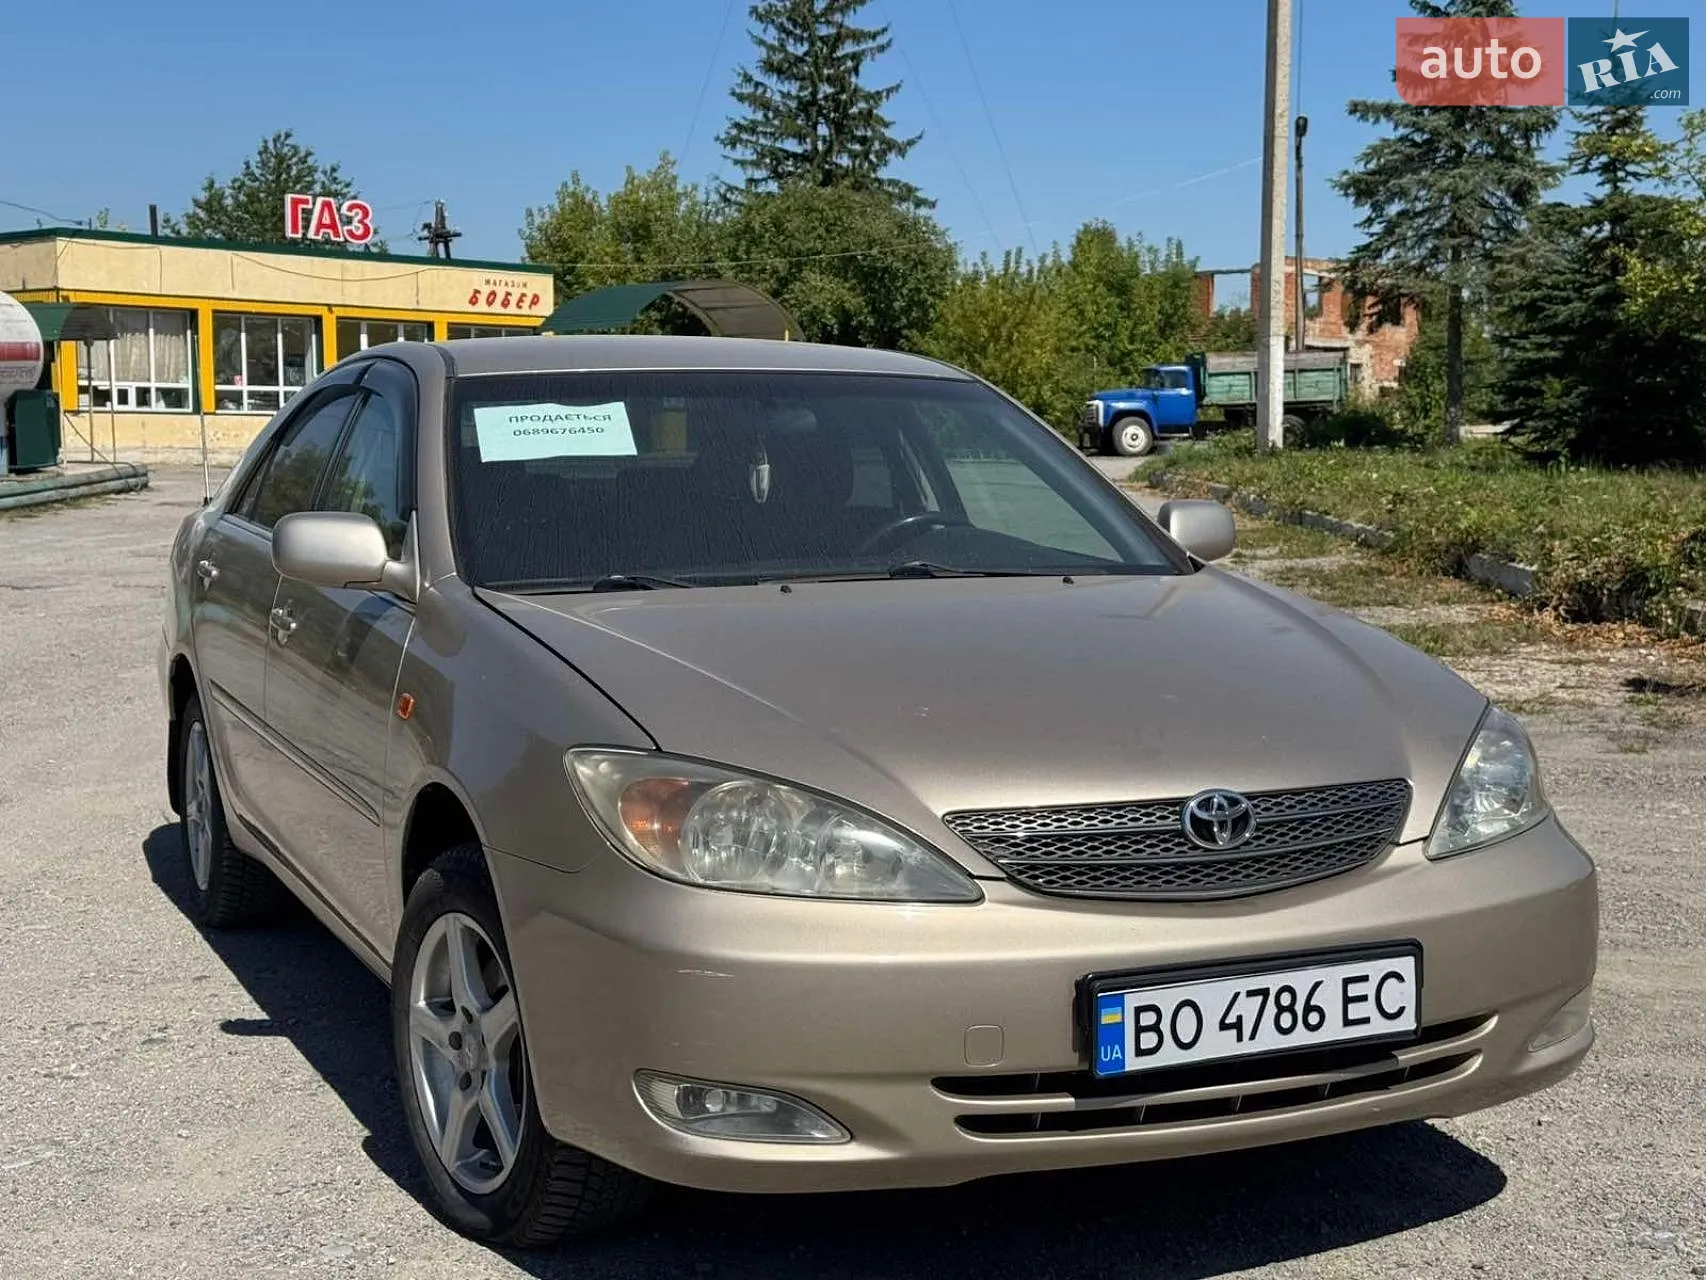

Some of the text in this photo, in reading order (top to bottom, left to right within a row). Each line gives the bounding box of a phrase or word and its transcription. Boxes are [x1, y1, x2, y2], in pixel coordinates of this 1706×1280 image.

[285, 194, 373, 243] ГАЗ
[484, 279, 528, 288] МАГАЗИН
[468, 289, 540, 310] БОБЕР
[513, 426, 605, 437] 0689676450
[1133, 971, 1407, 1058] BO 4786 EC
[1101, 1045, 1122, 1062] UA
